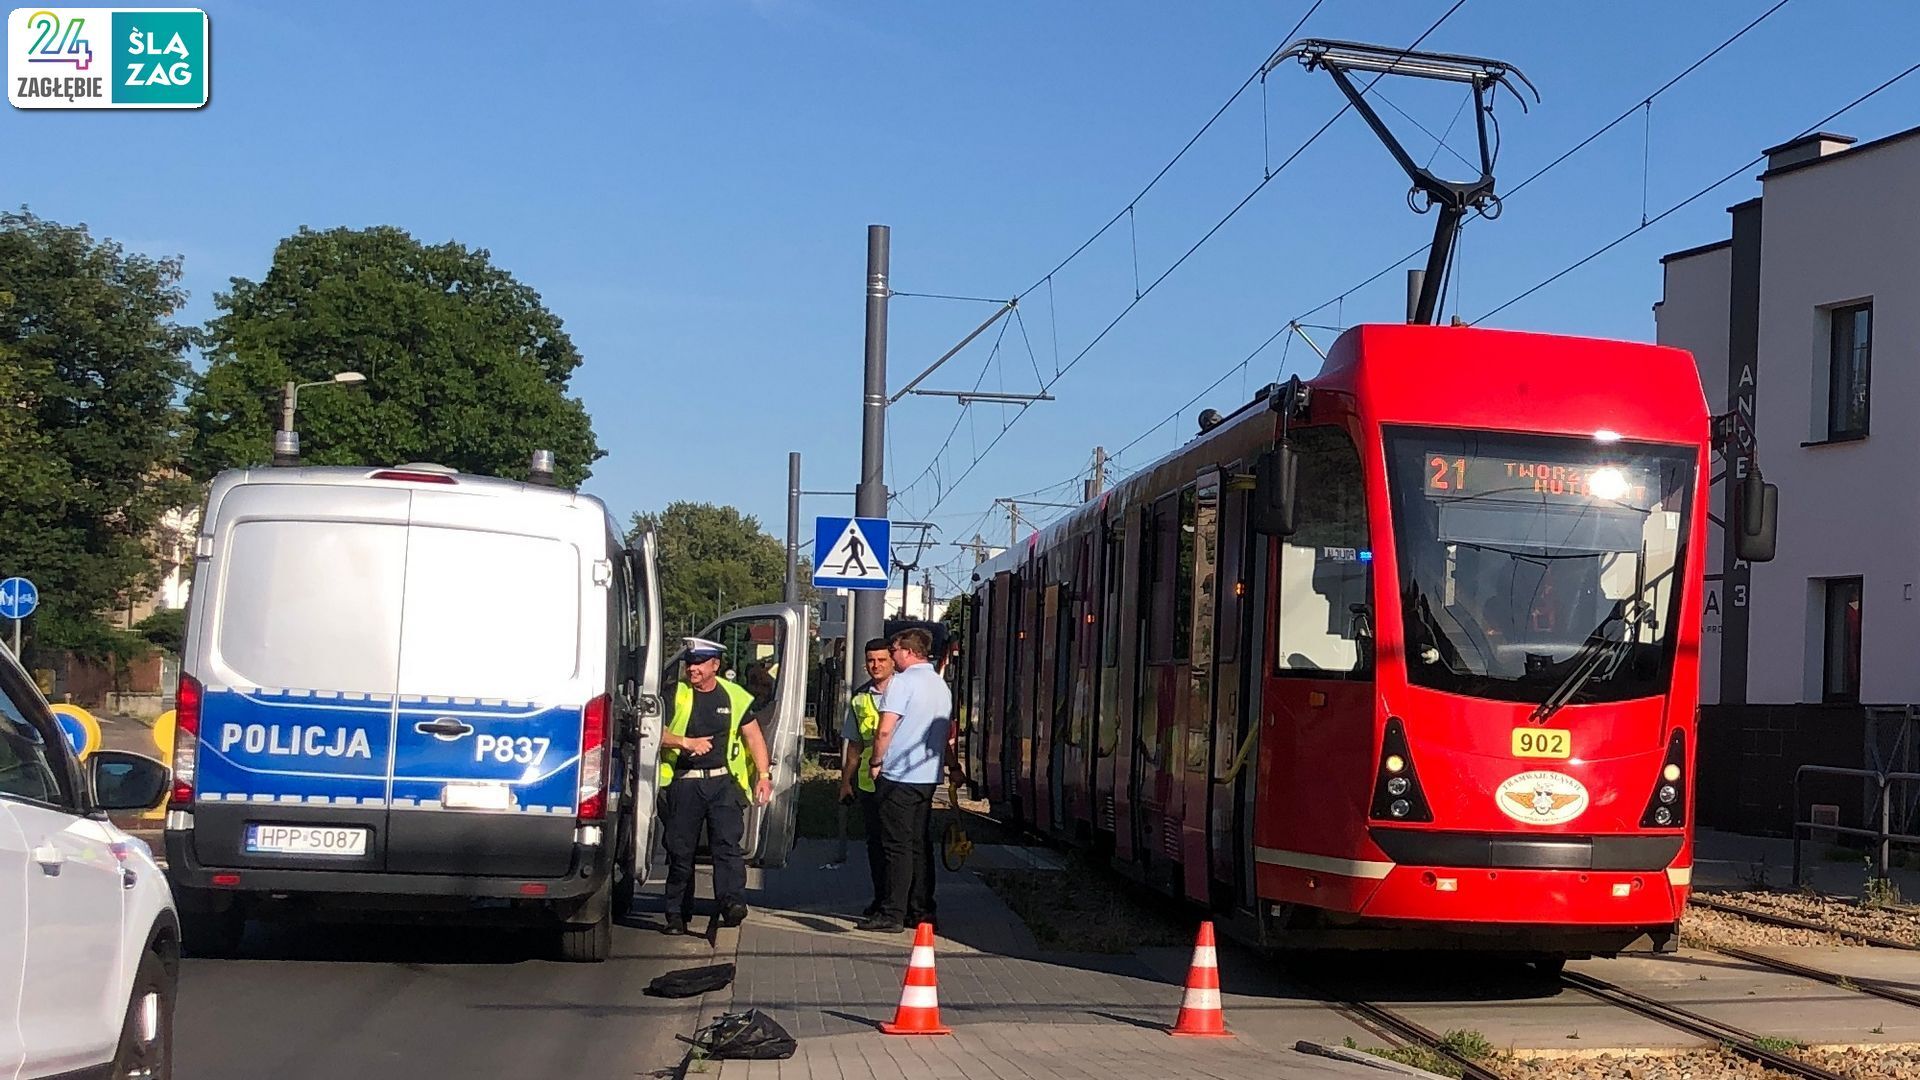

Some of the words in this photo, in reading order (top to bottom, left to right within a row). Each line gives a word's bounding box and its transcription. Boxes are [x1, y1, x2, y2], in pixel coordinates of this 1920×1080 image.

[1430, 457, 1465, 490] 21
[1503, 462, 1596, 484] TWORZ
[1734, 584, 1747, 607] 3
[221, 723, 372, 759] POLICJA
[475, 734, 550, 766] P837
[1520, 733, 1563, 753] 902
[261, 828, 302, 847] HPP
[309, 830, 361, 849] S087
